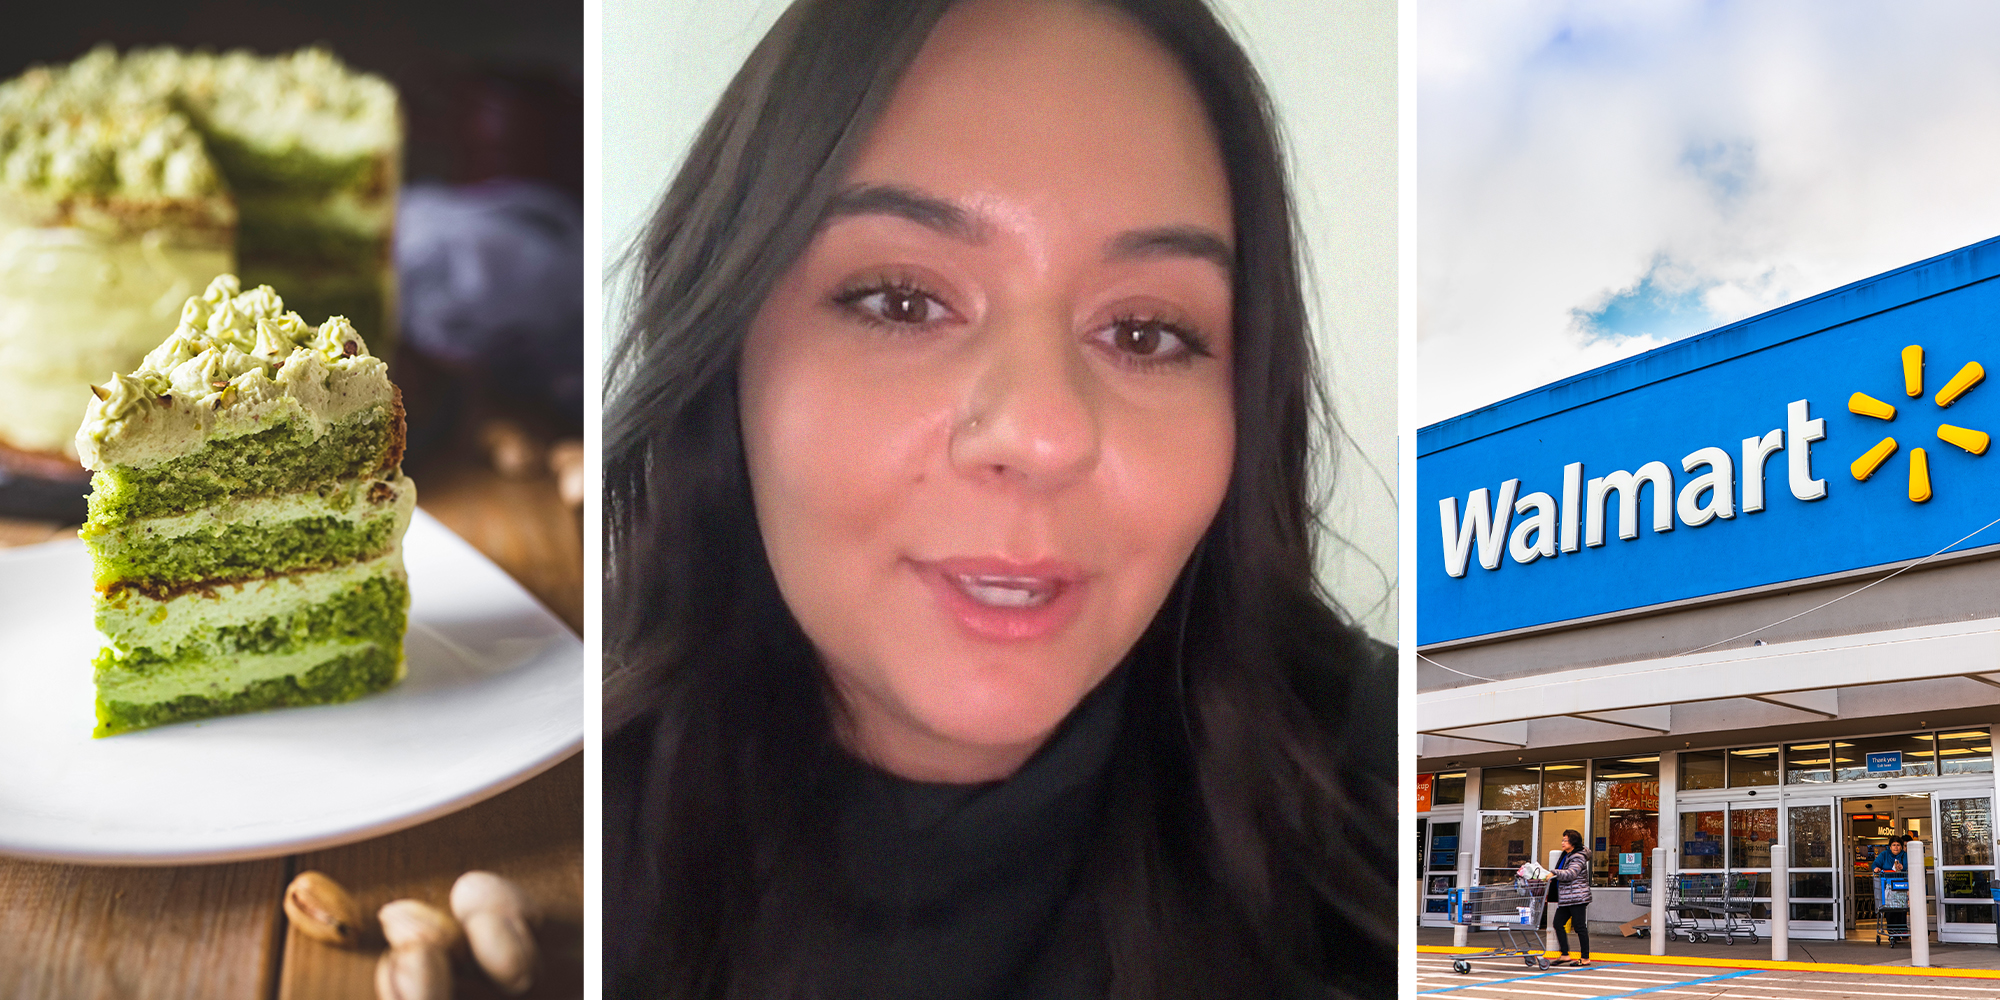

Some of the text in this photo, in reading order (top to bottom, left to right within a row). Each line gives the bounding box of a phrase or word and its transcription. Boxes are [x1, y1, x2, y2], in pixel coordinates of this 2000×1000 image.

[1438, 398, 1828, 579] Walmart
[1641, 795, 1659, 809] Here
[1705, 816, 1724, 829] Free
